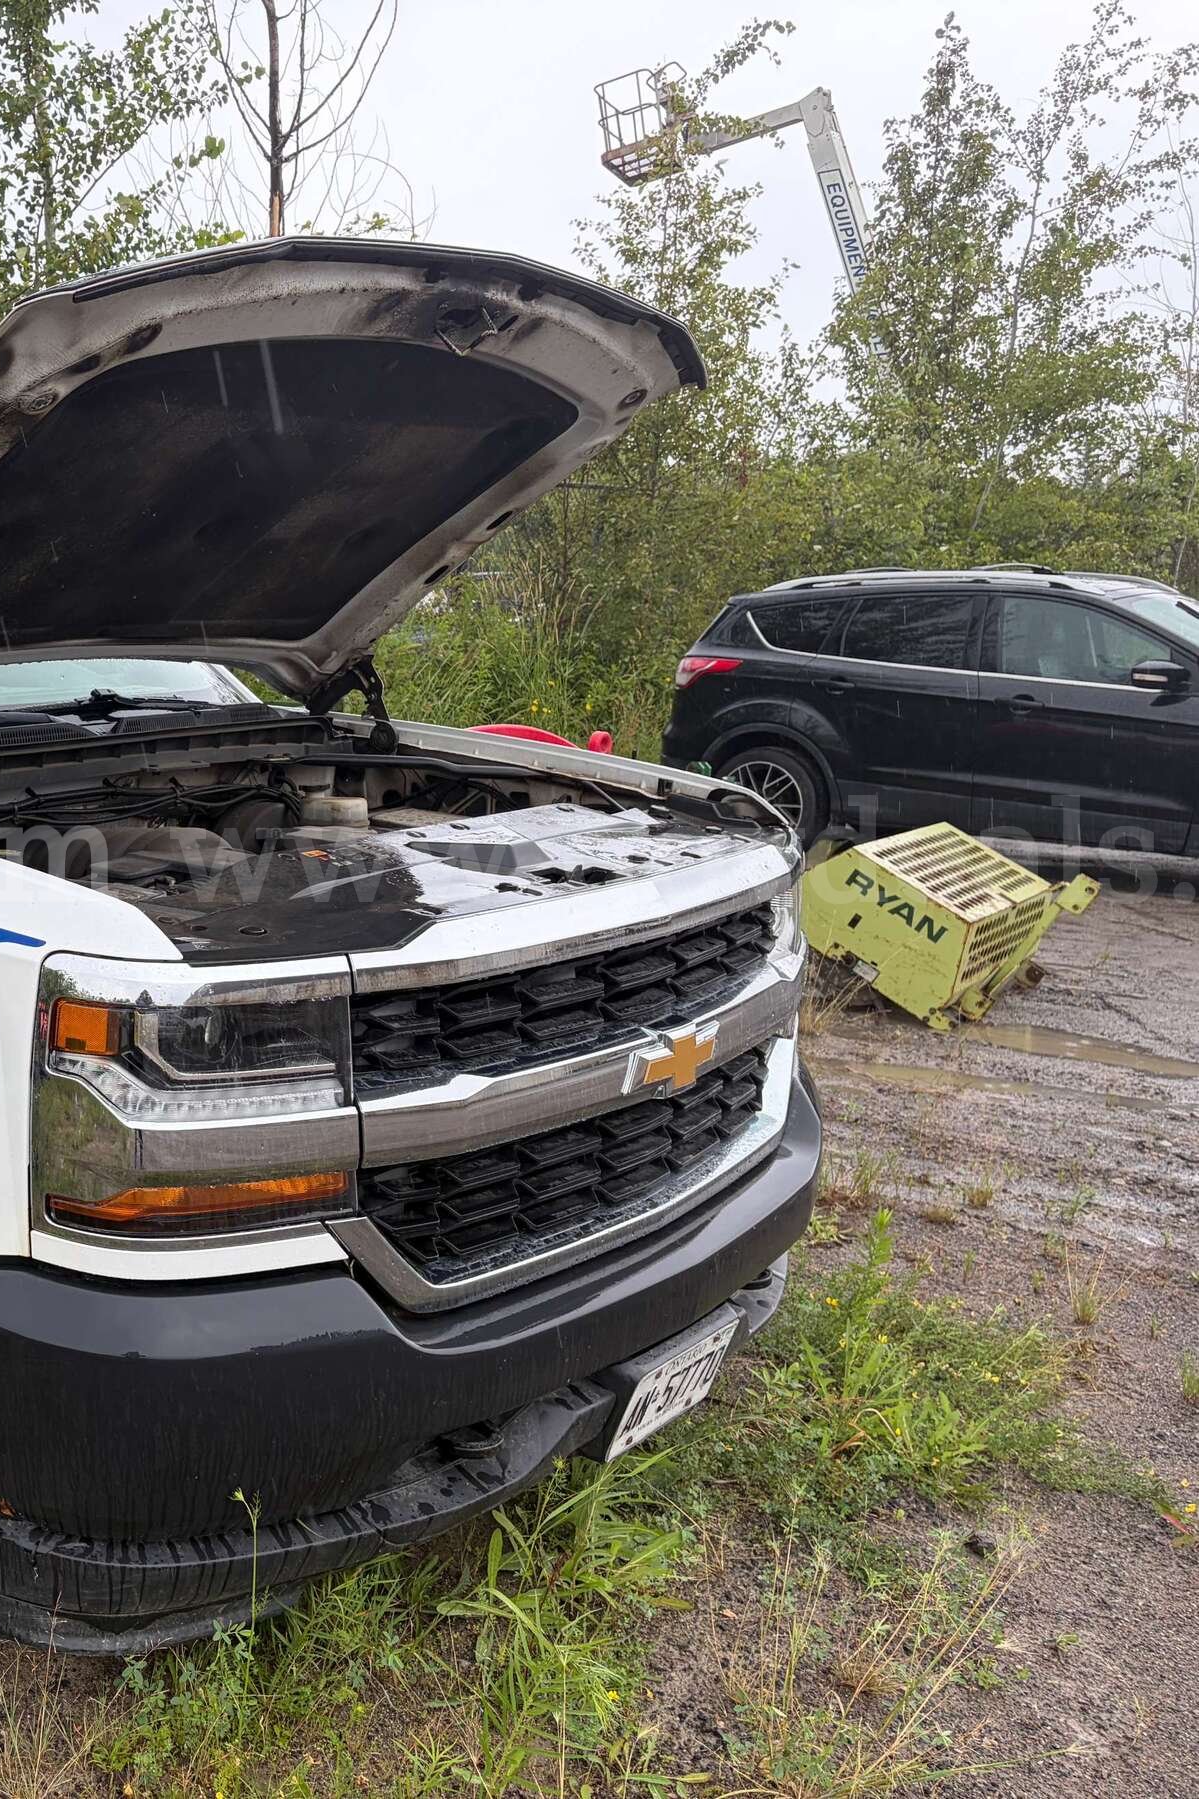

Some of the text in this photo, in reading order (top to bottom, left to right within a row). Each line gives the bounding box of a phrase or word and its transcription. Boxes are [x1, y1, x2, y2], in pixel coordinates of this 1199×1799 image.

[826, 182, 867, 283] EQUIPMEN
[845, 868, 948, 944] RYAN
[656, 1344, 726, 1413] 57770
